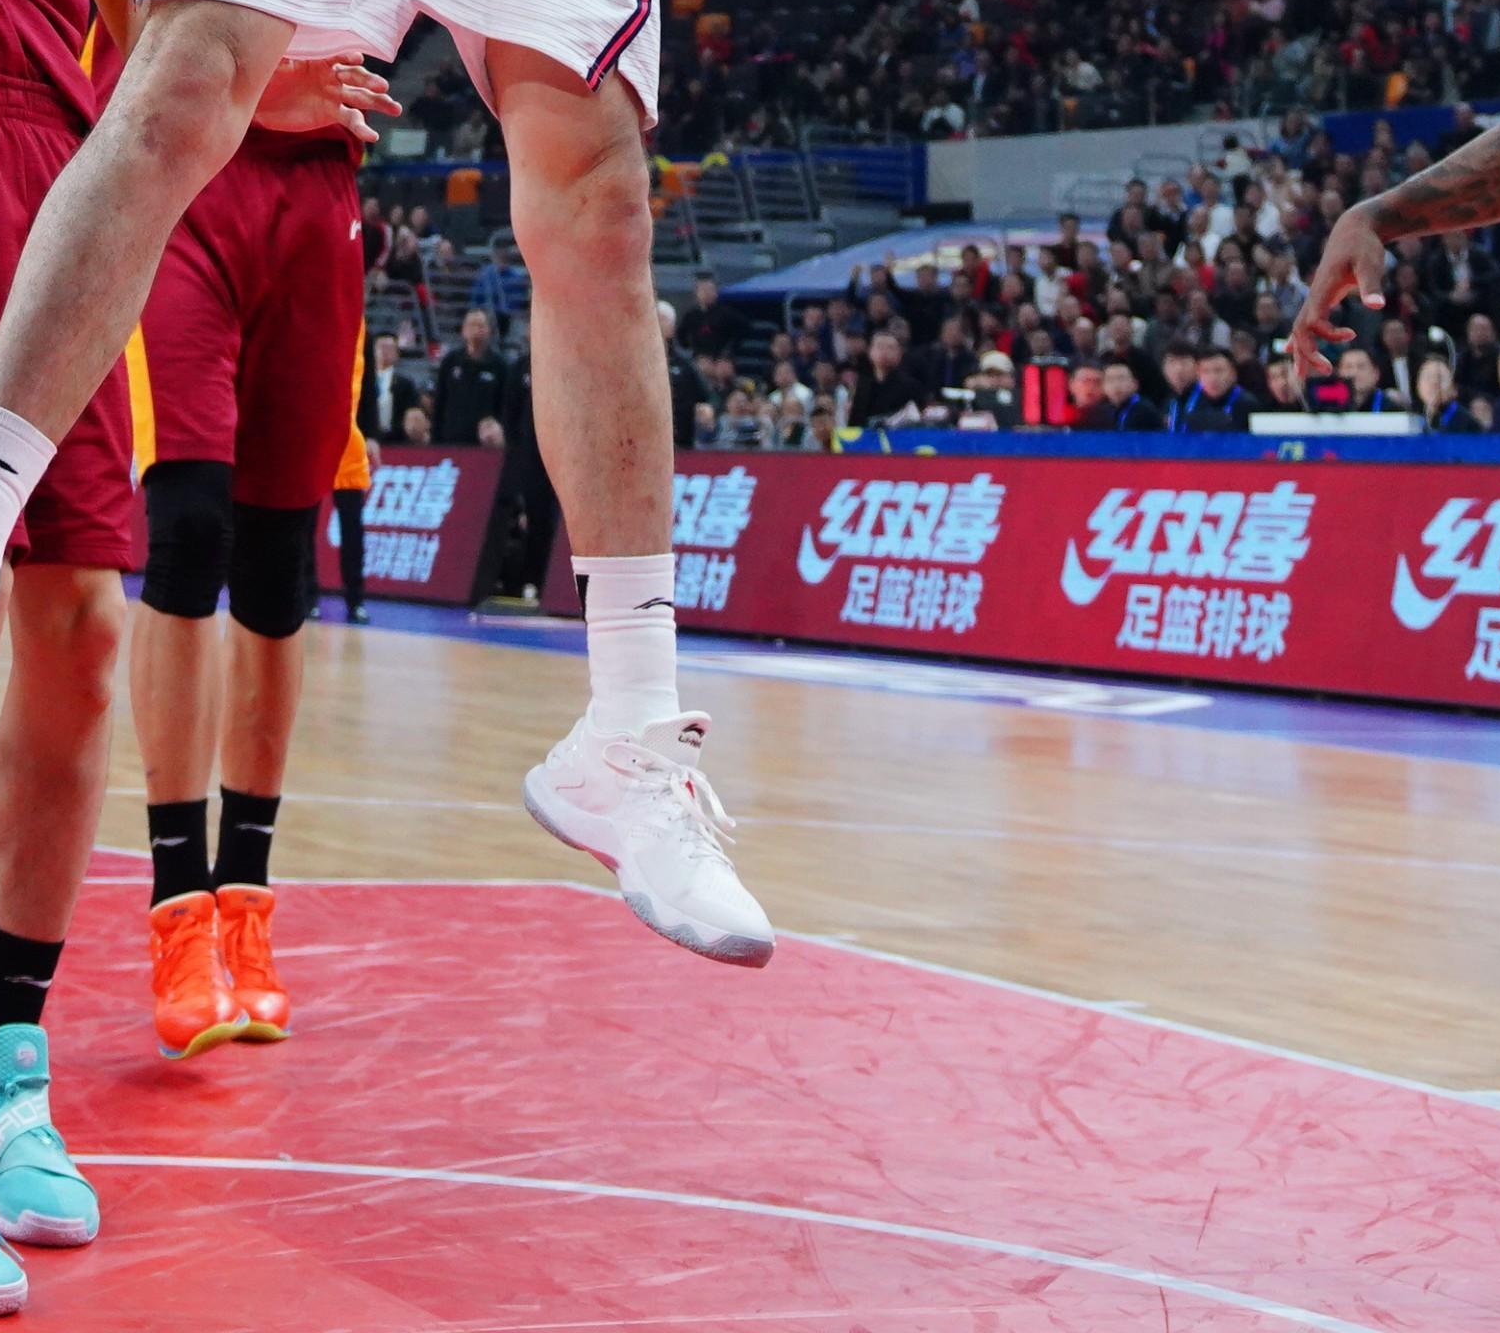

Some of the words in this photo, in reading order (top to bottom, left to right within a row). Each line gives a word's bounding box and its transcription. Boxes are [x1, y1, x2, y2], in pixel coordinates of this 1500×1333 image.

[817, 472, 1007, 565] 红双喜
[1085, 480, 1317, 583] 红双喜
[839, 563, 984, 634] 足篮排球
[1115, 583, 1293, 664] 足篮排球
